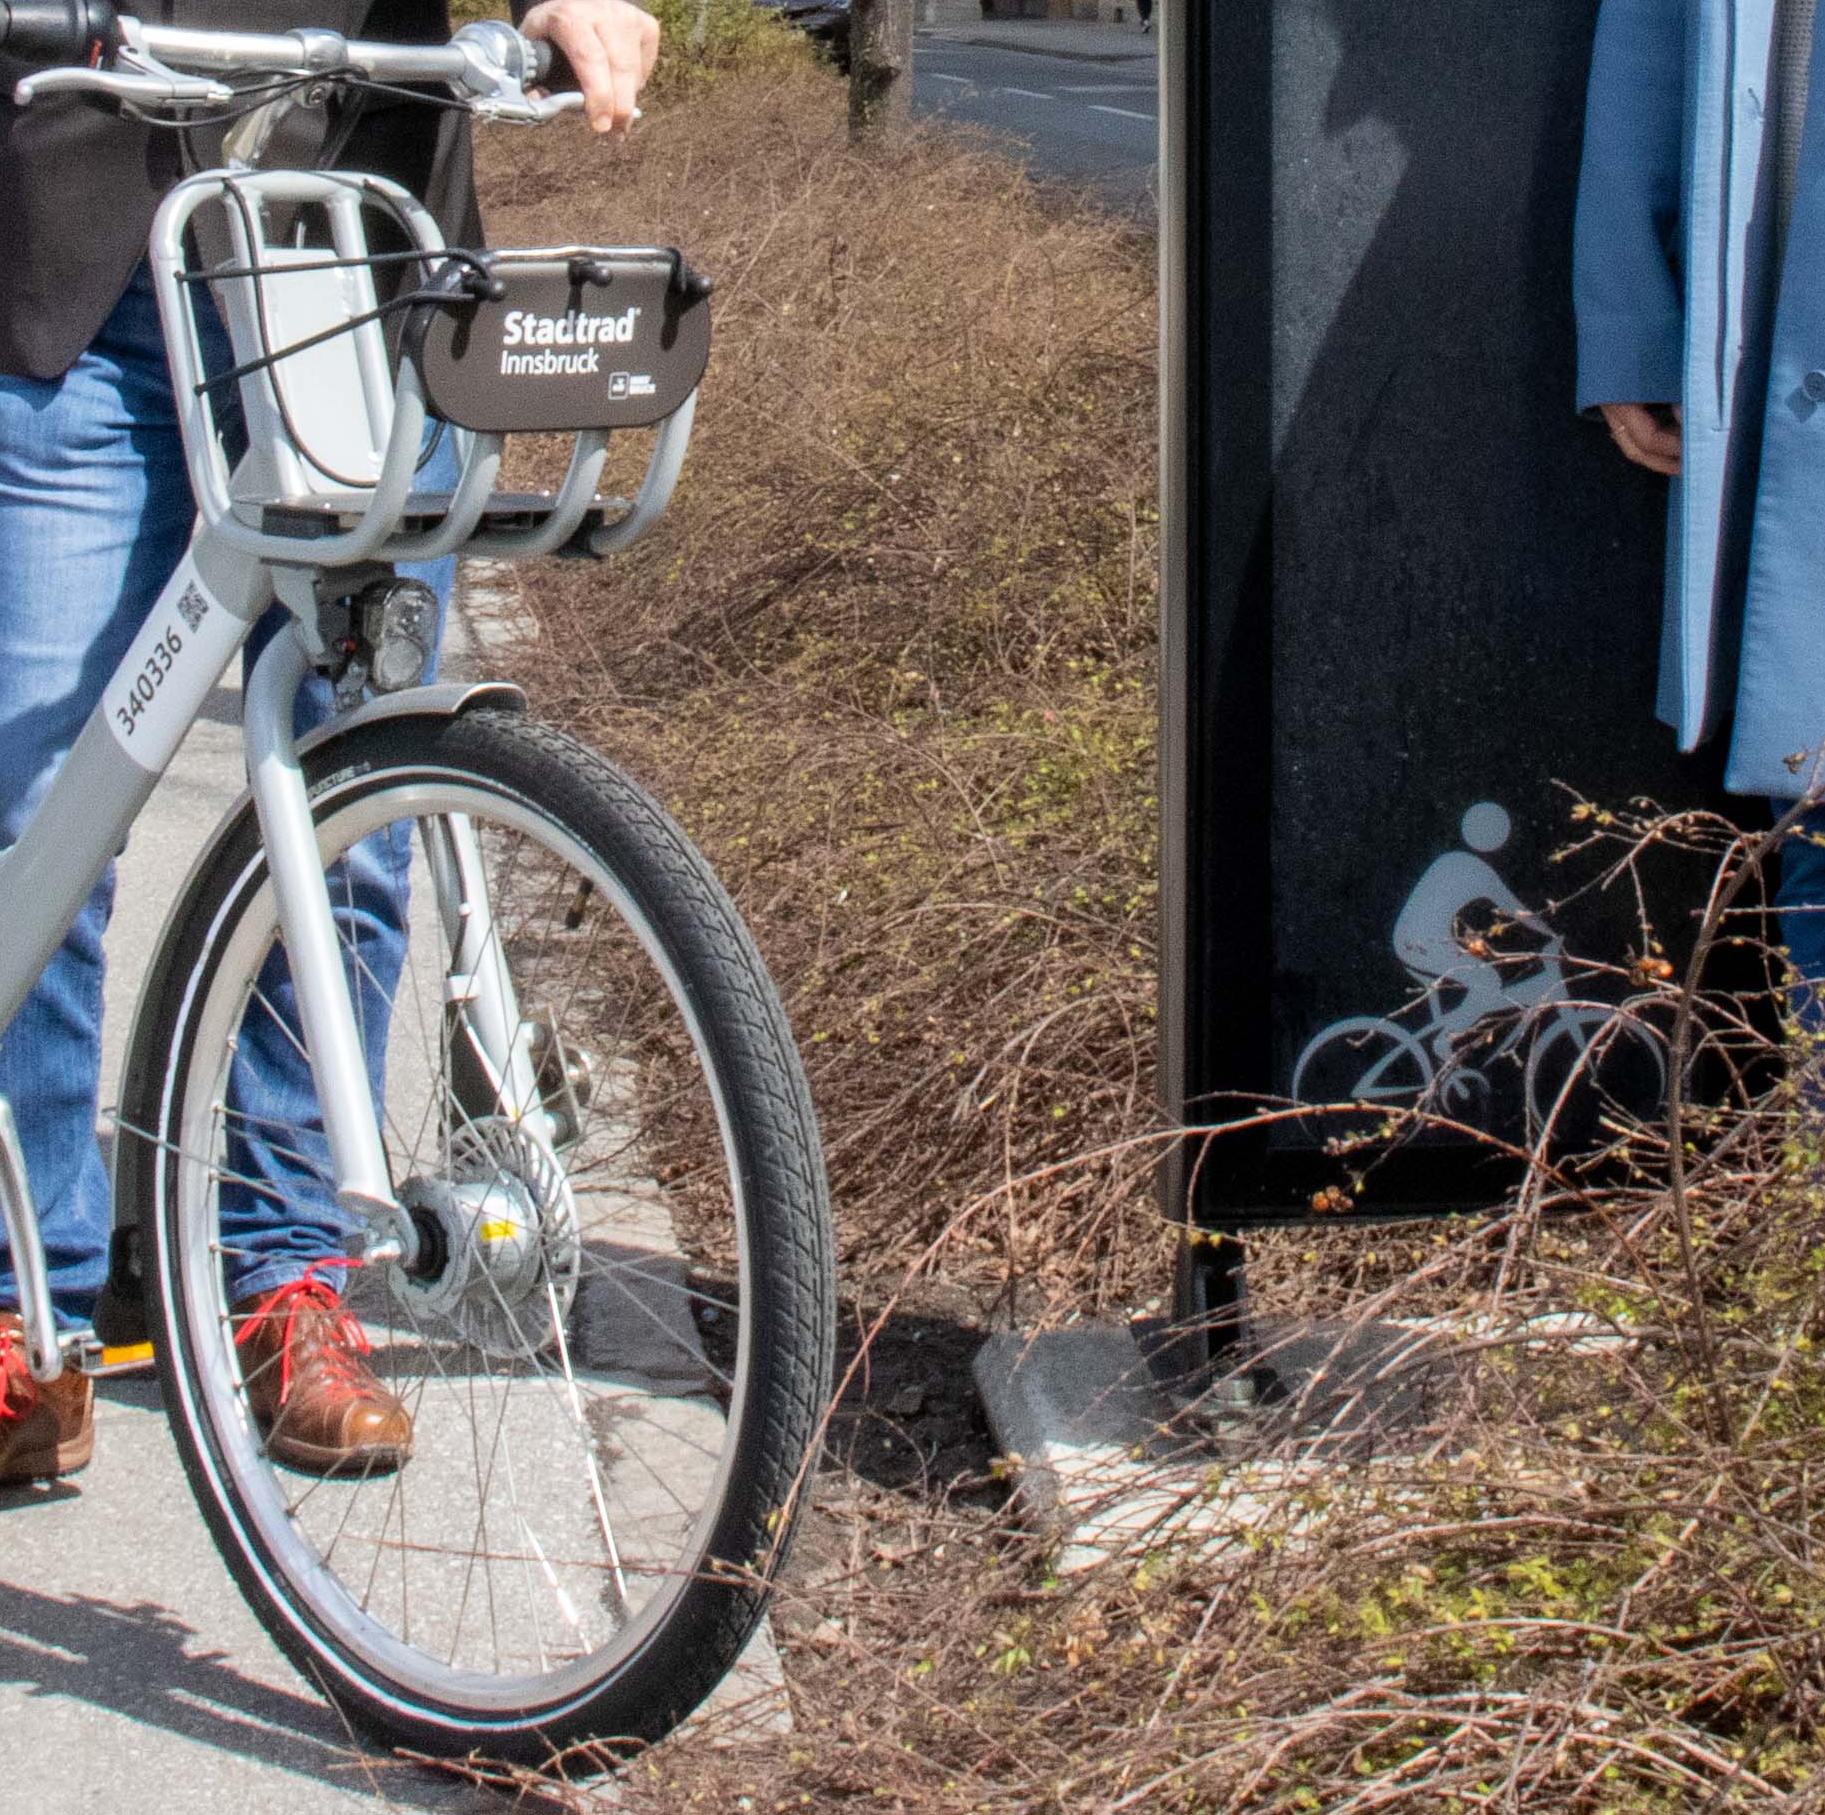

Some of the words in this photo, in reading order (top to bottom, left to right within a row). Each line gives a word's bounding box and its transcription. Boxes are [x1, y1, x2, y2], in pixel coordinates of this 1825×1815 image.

[502, 307, 637, 345] Stadtrad
[500, 347, 600, 375] Innsbruck
[116, 624, 183, 736] 340336
